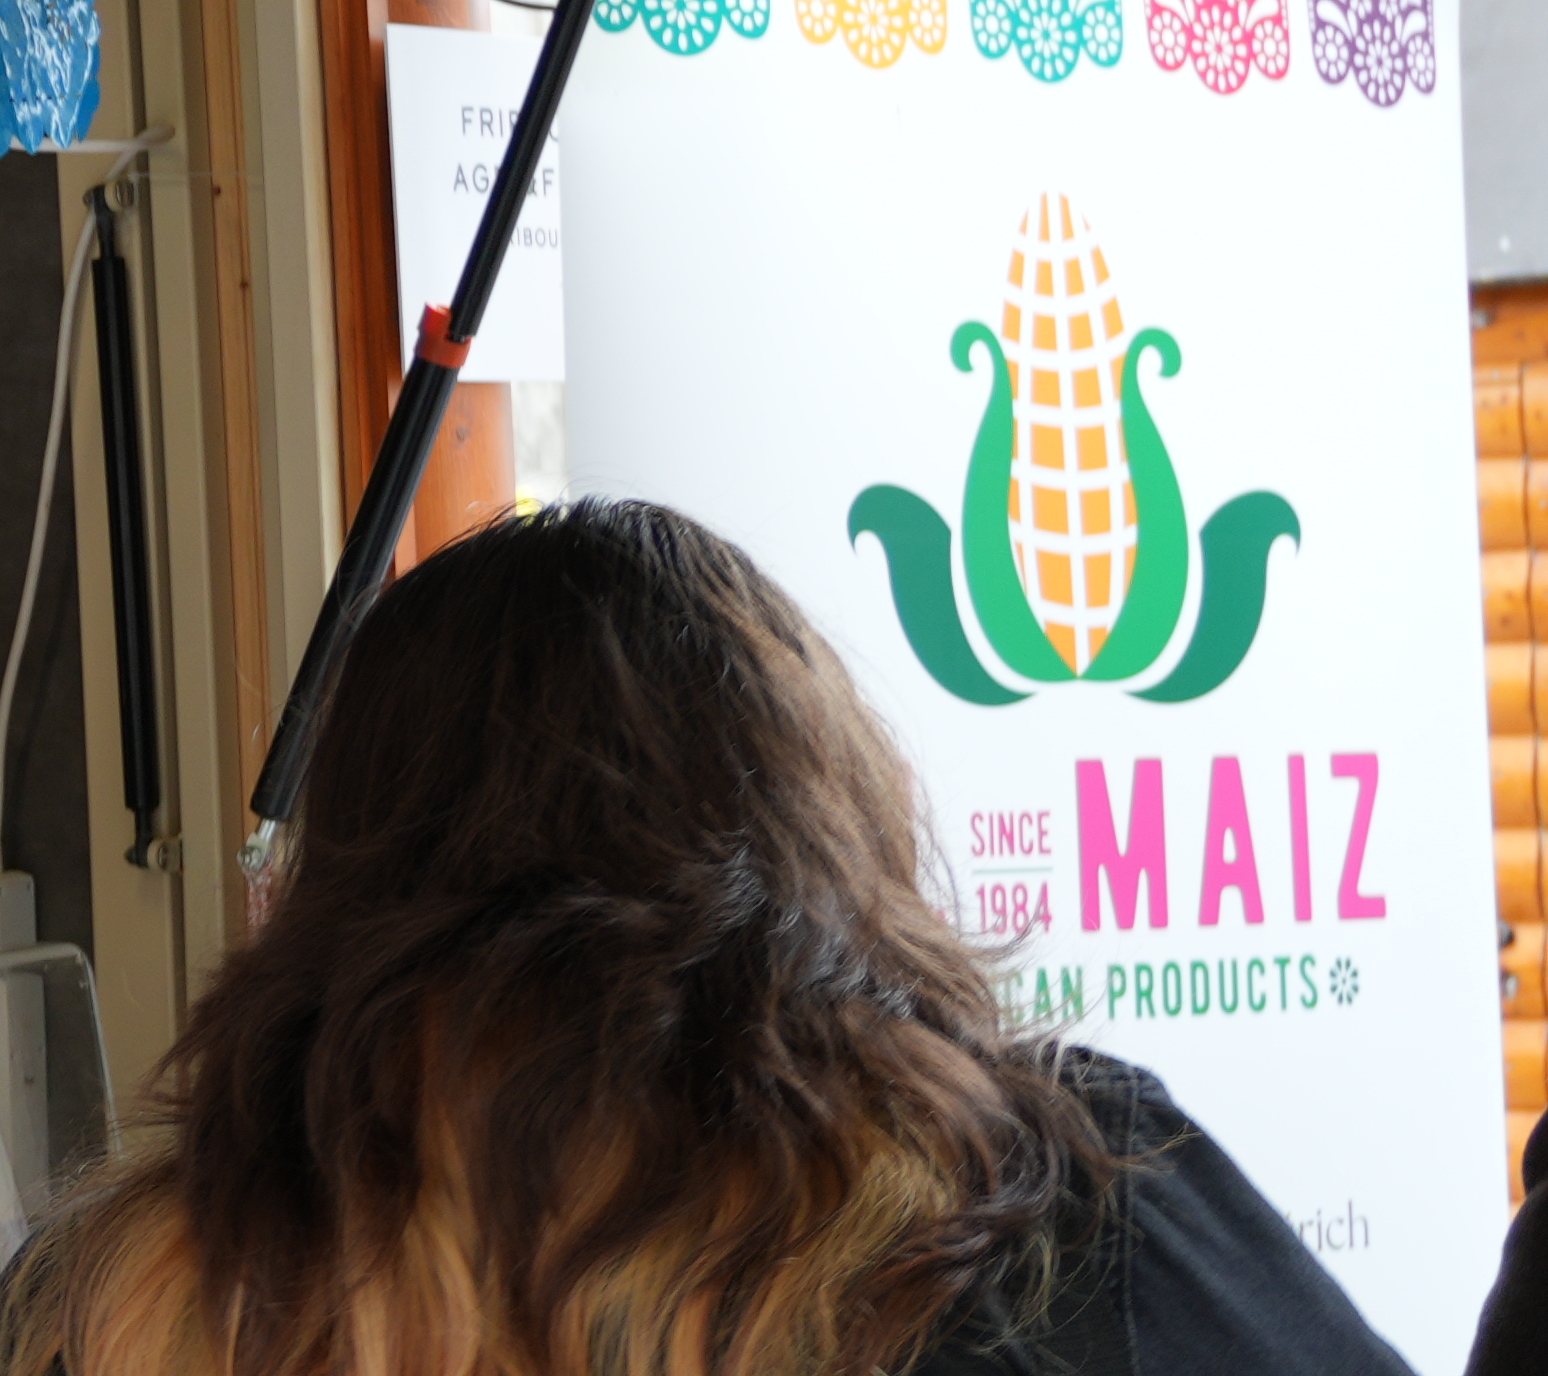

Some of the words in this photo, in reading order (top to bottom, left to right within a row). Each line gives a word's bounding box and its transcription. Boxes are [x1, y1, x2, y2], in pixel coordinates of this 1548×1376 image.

[970, 810, 1052, 858] SINCE
[1074, 750, 1388, 933] MAIZ
[975, 881, 1054, 936] 1984
[1107, 954, 1320, 1021] PRODUCTS
